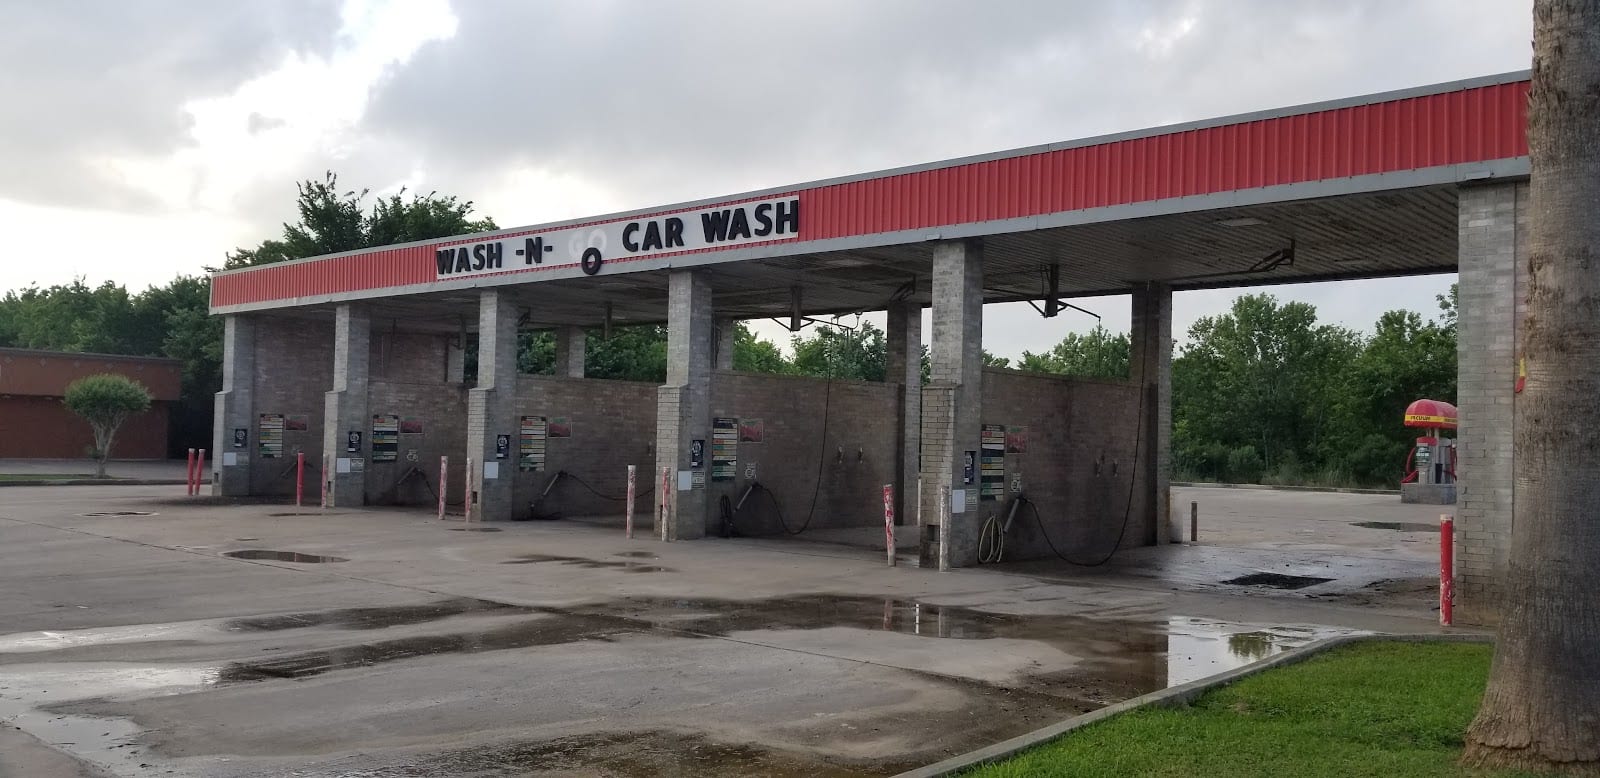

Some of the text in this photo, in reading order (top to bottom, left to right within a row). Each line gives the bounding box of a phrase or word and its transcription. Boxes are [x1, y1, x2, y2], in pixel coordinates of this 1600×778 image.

[437, 244, 502, 275] WASH
[622, 218, 684, 252] CAR
[701, 200, 799, 243] WASH
